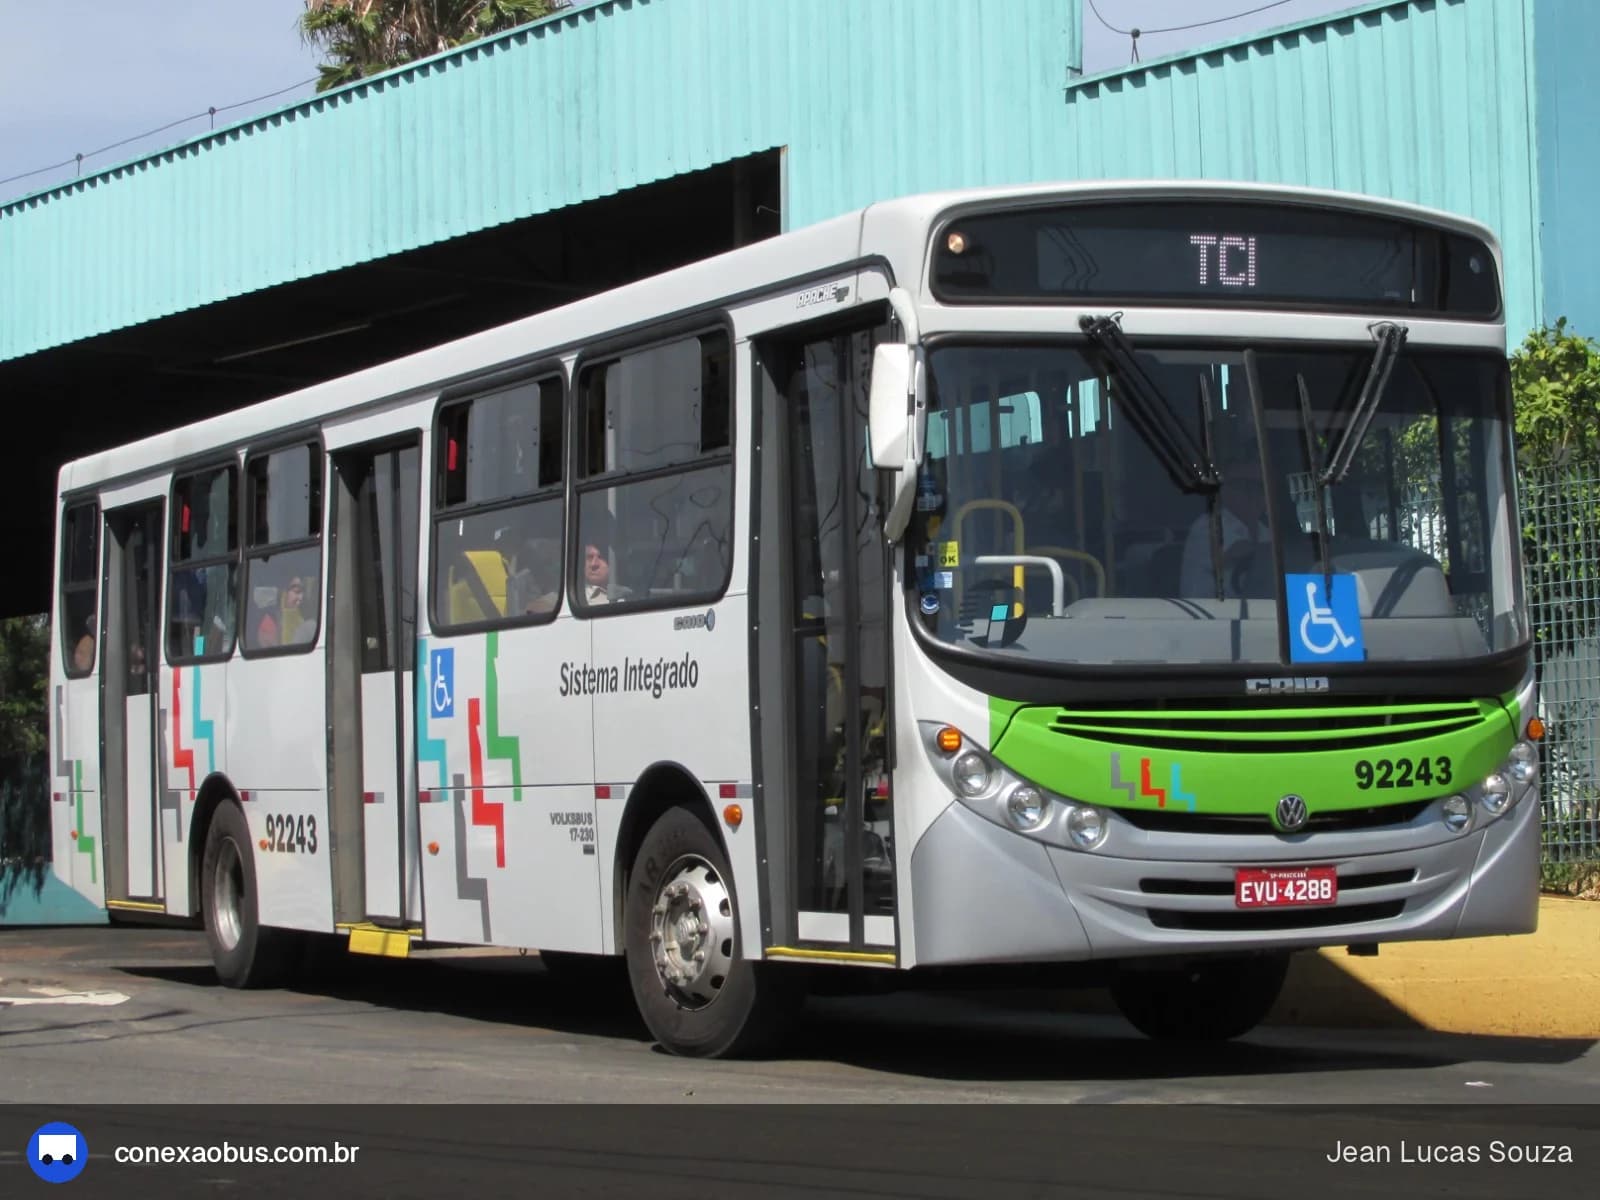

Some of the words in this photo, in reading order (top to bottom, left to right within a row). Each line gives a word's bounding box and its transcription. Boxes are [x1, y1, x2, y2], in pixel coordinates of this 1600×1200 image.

[1190, 235, 1255, 287] TCI
[797, 283, 838, 308] APACHE
[559, 661, 618, 697] Sistema
[623, 651, 699, 699] Integrado
[1246, 677, 1329, 695] CAIO
[1355, 756, 1452, 790] 92243
[549, 811, 593, 826] VOLKSBUS
[266, 813, 318, 855] 92243
[569, 827, 594, 842] 17-230
